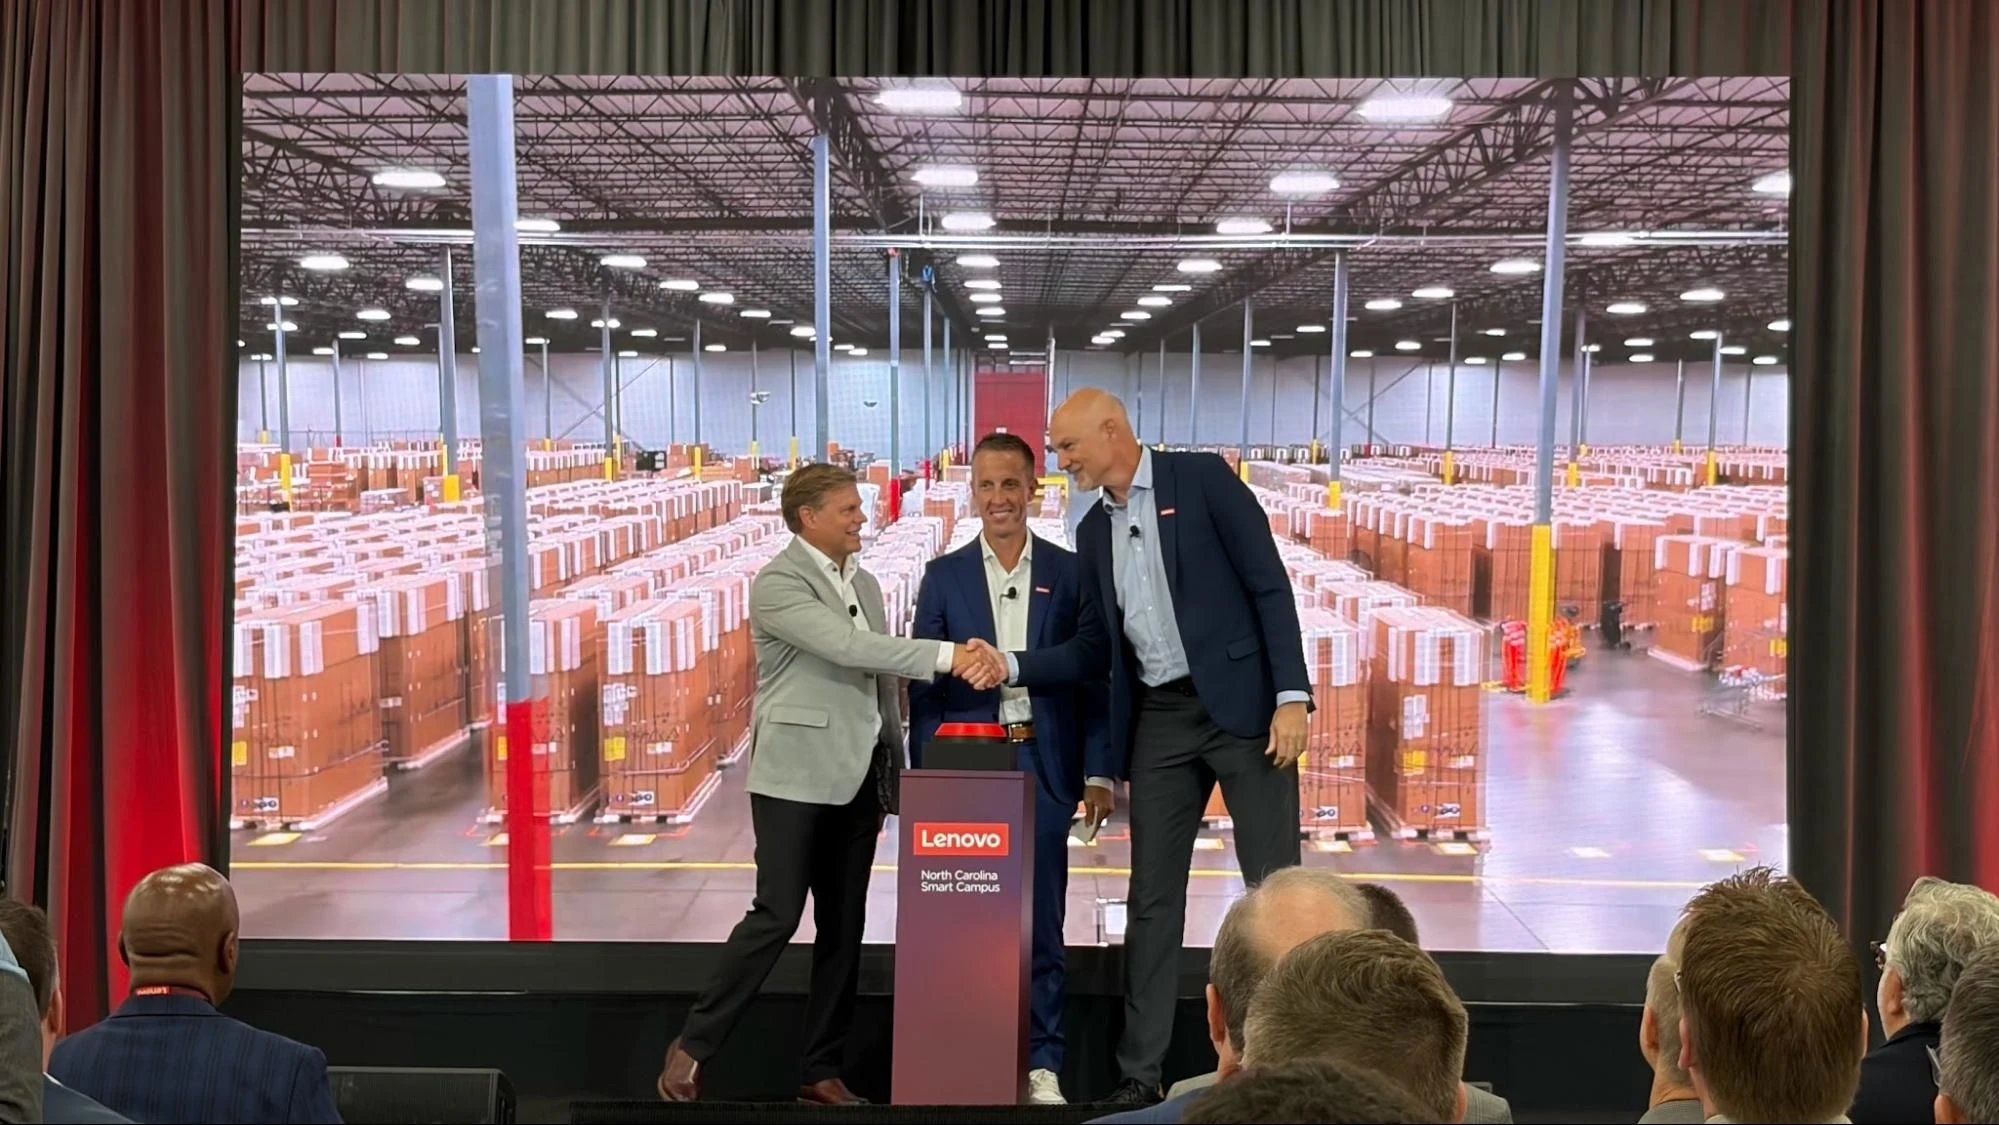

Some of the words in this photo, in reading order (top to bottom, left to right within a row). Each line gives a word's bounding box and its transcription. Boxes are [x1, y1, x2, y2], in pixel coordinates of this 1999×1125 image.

[921, 829, 1001, 848] Lenovo
[921, 869, 952, 881] North
[954, 869, 998, 881] Carolina
[921, 881, 954, 893] Smart
[956, 881, 1000, 894] Campus
